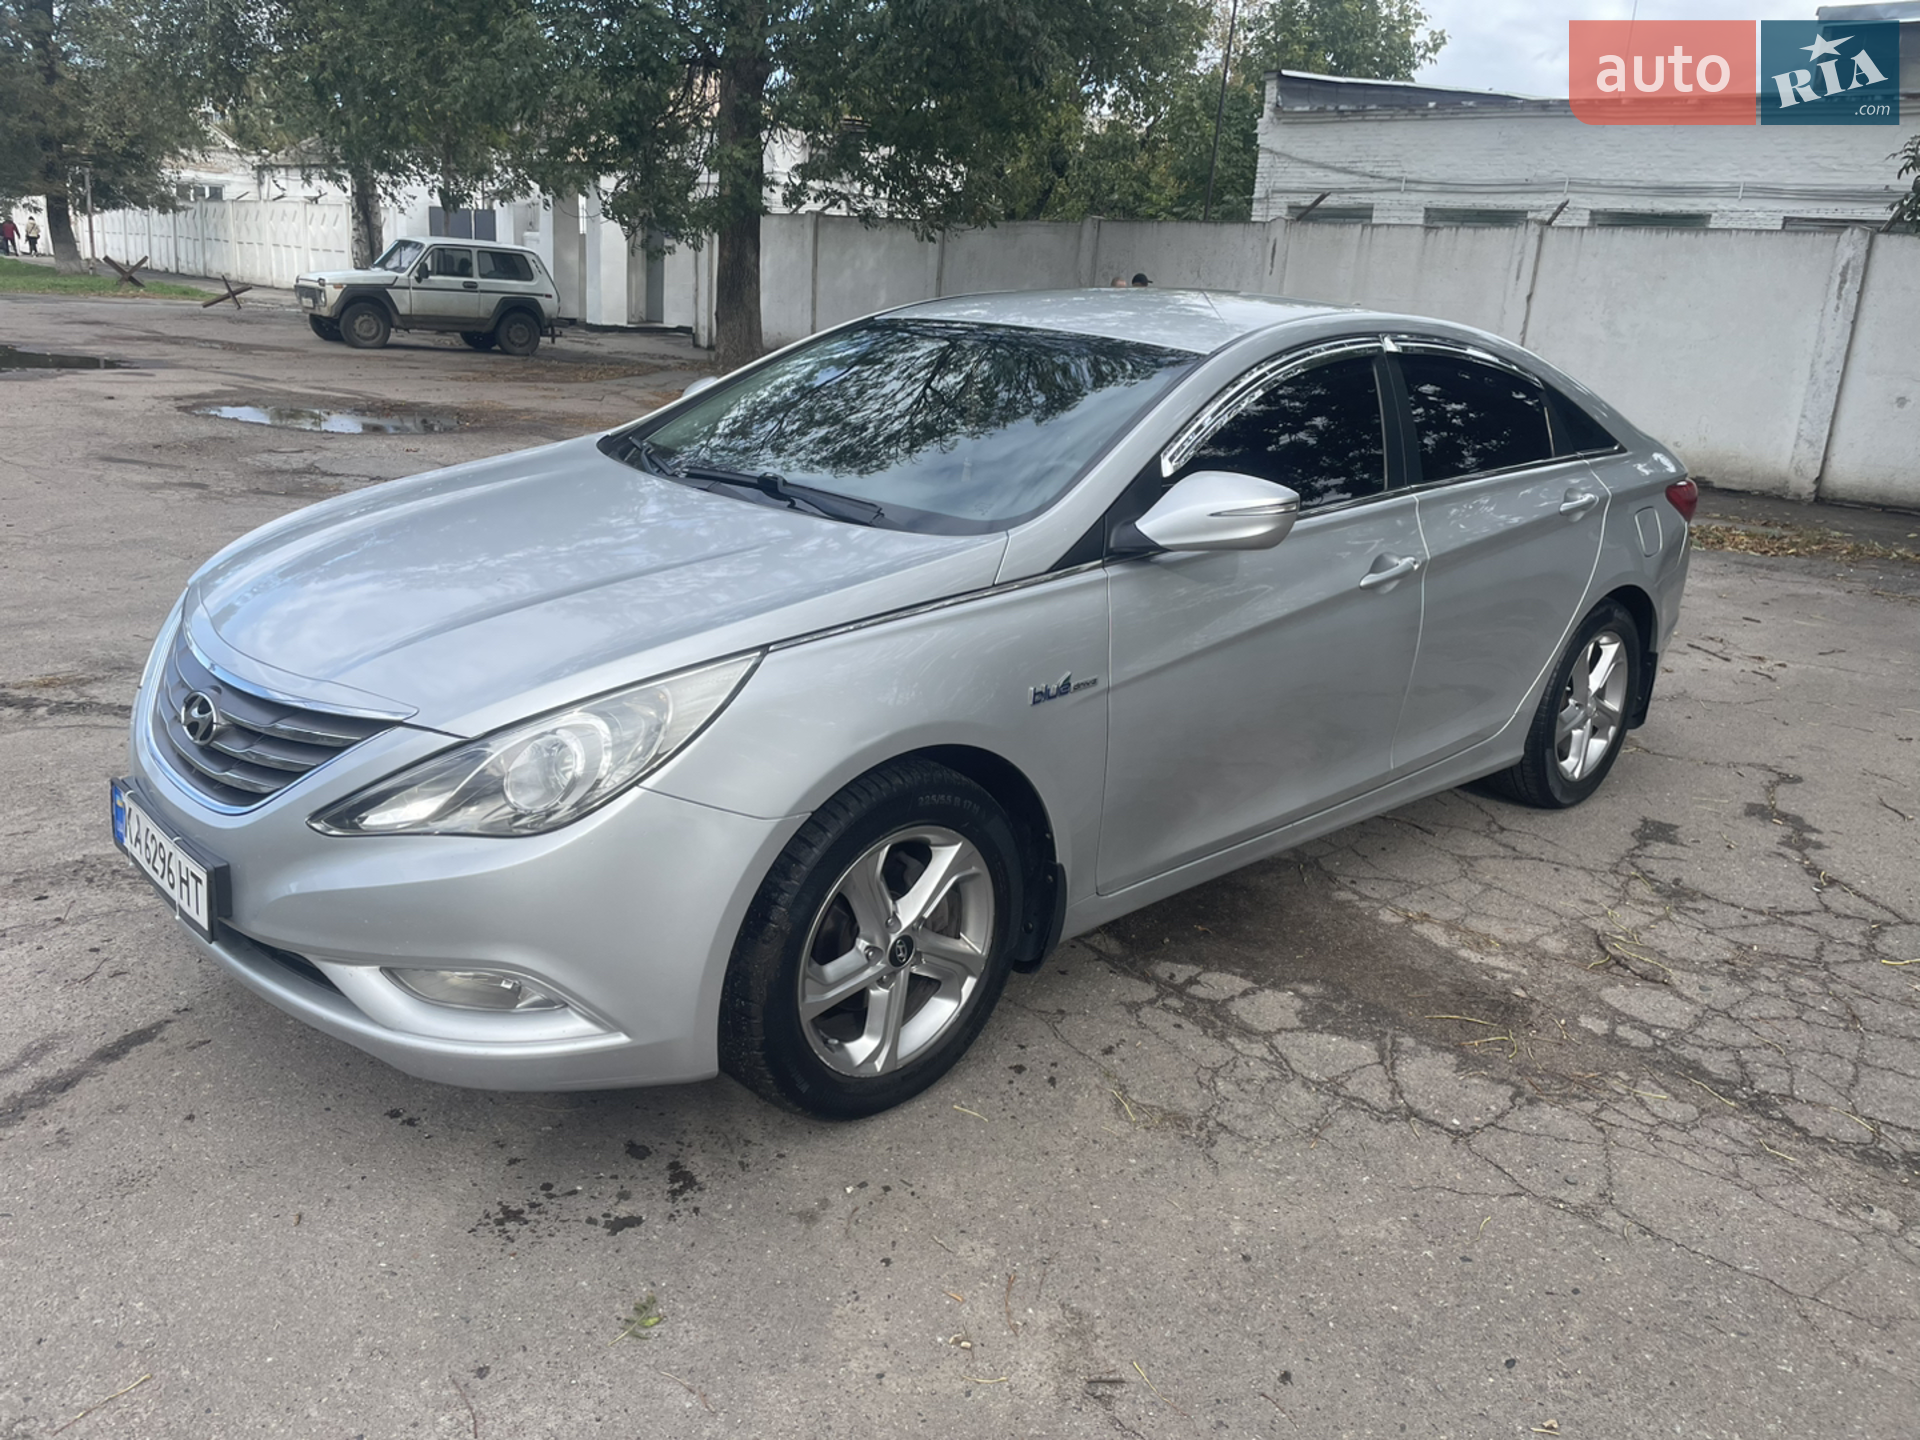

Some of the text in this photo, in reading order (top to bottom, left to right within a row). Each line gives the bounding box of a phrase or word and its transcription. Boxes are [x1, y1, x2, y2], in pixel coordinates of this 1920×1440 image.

[1028, 676, 1071, 706] blue
[144, 827, 176, 890] 6296
[178, 860, 203, 916] HT
